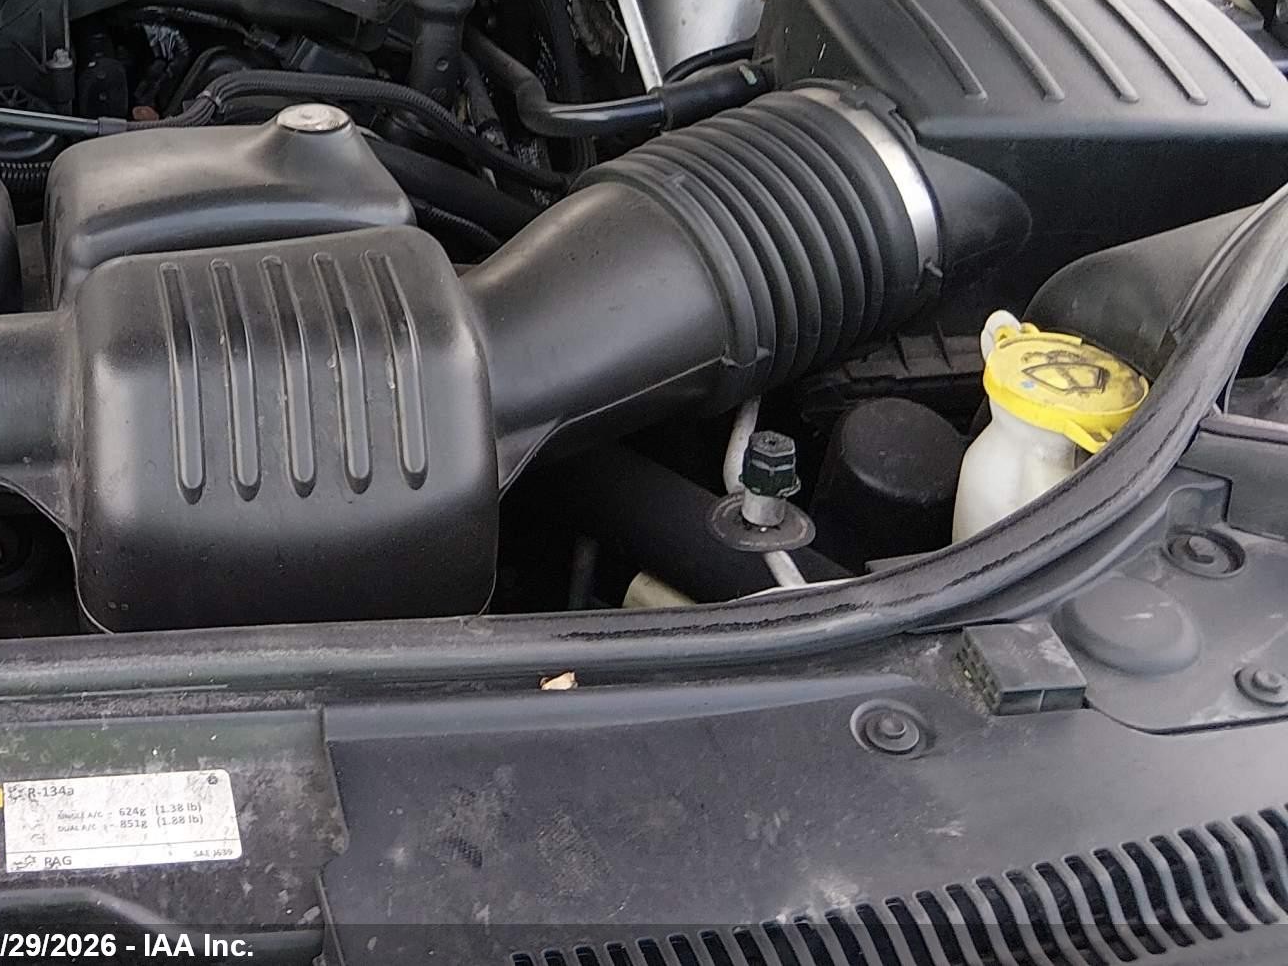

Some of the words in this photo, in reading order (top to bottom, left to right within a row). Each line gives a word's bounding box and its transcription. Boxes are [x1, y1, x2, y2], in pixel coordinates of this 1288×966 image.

[28, 786, 75, 798] R-134a
[119, 806, 147, 817] 624g
[155, 803, 184, 815] (1.38
[187, 801, 202, 813] lb)
[120, 819, 148, 829] 851g
[157, 816, 186, 828] (1.88
[188, 813, 203, 825] lb)
